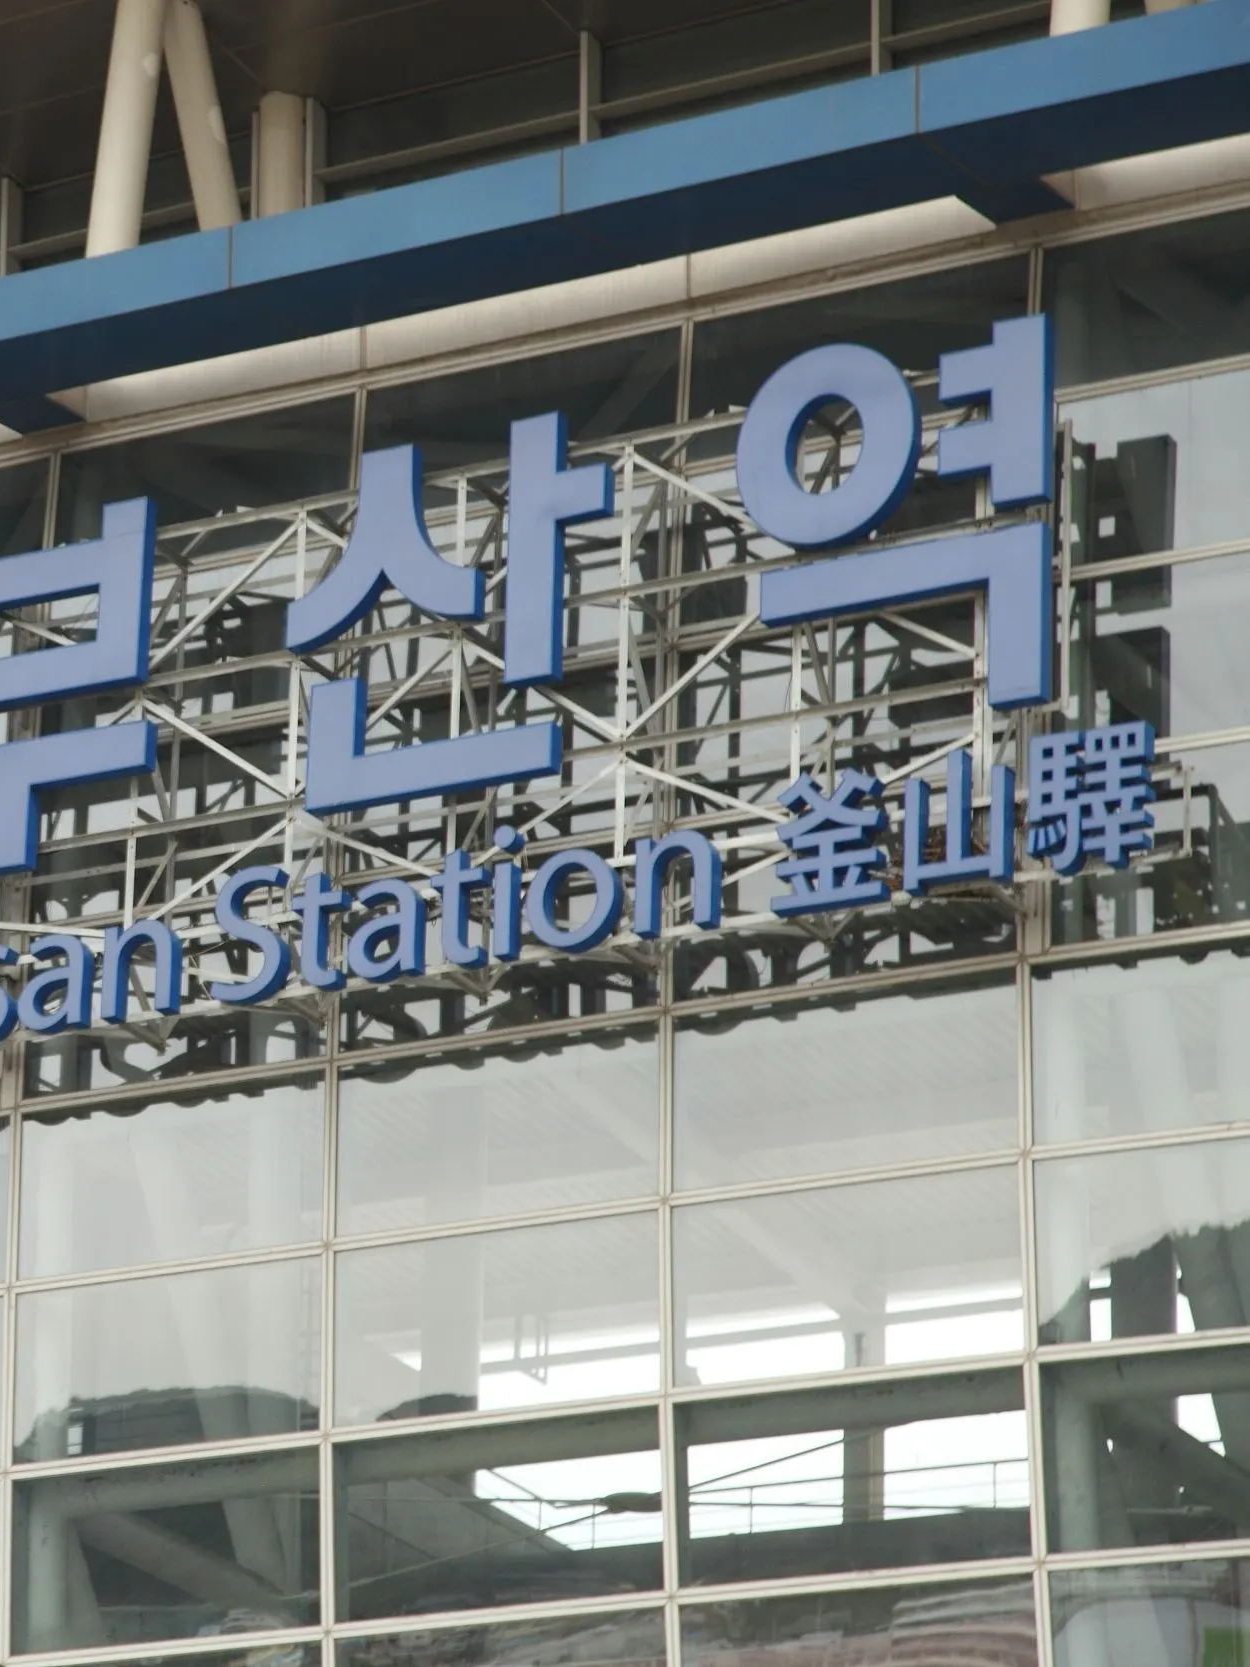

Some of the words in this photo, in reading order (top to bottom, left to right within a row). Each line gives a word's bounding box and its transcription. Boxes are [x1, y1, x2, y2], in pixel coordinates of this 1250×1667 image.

[210, 825, 722, 1003] Station
[770, 720, 1156, 917] 釜山驛
